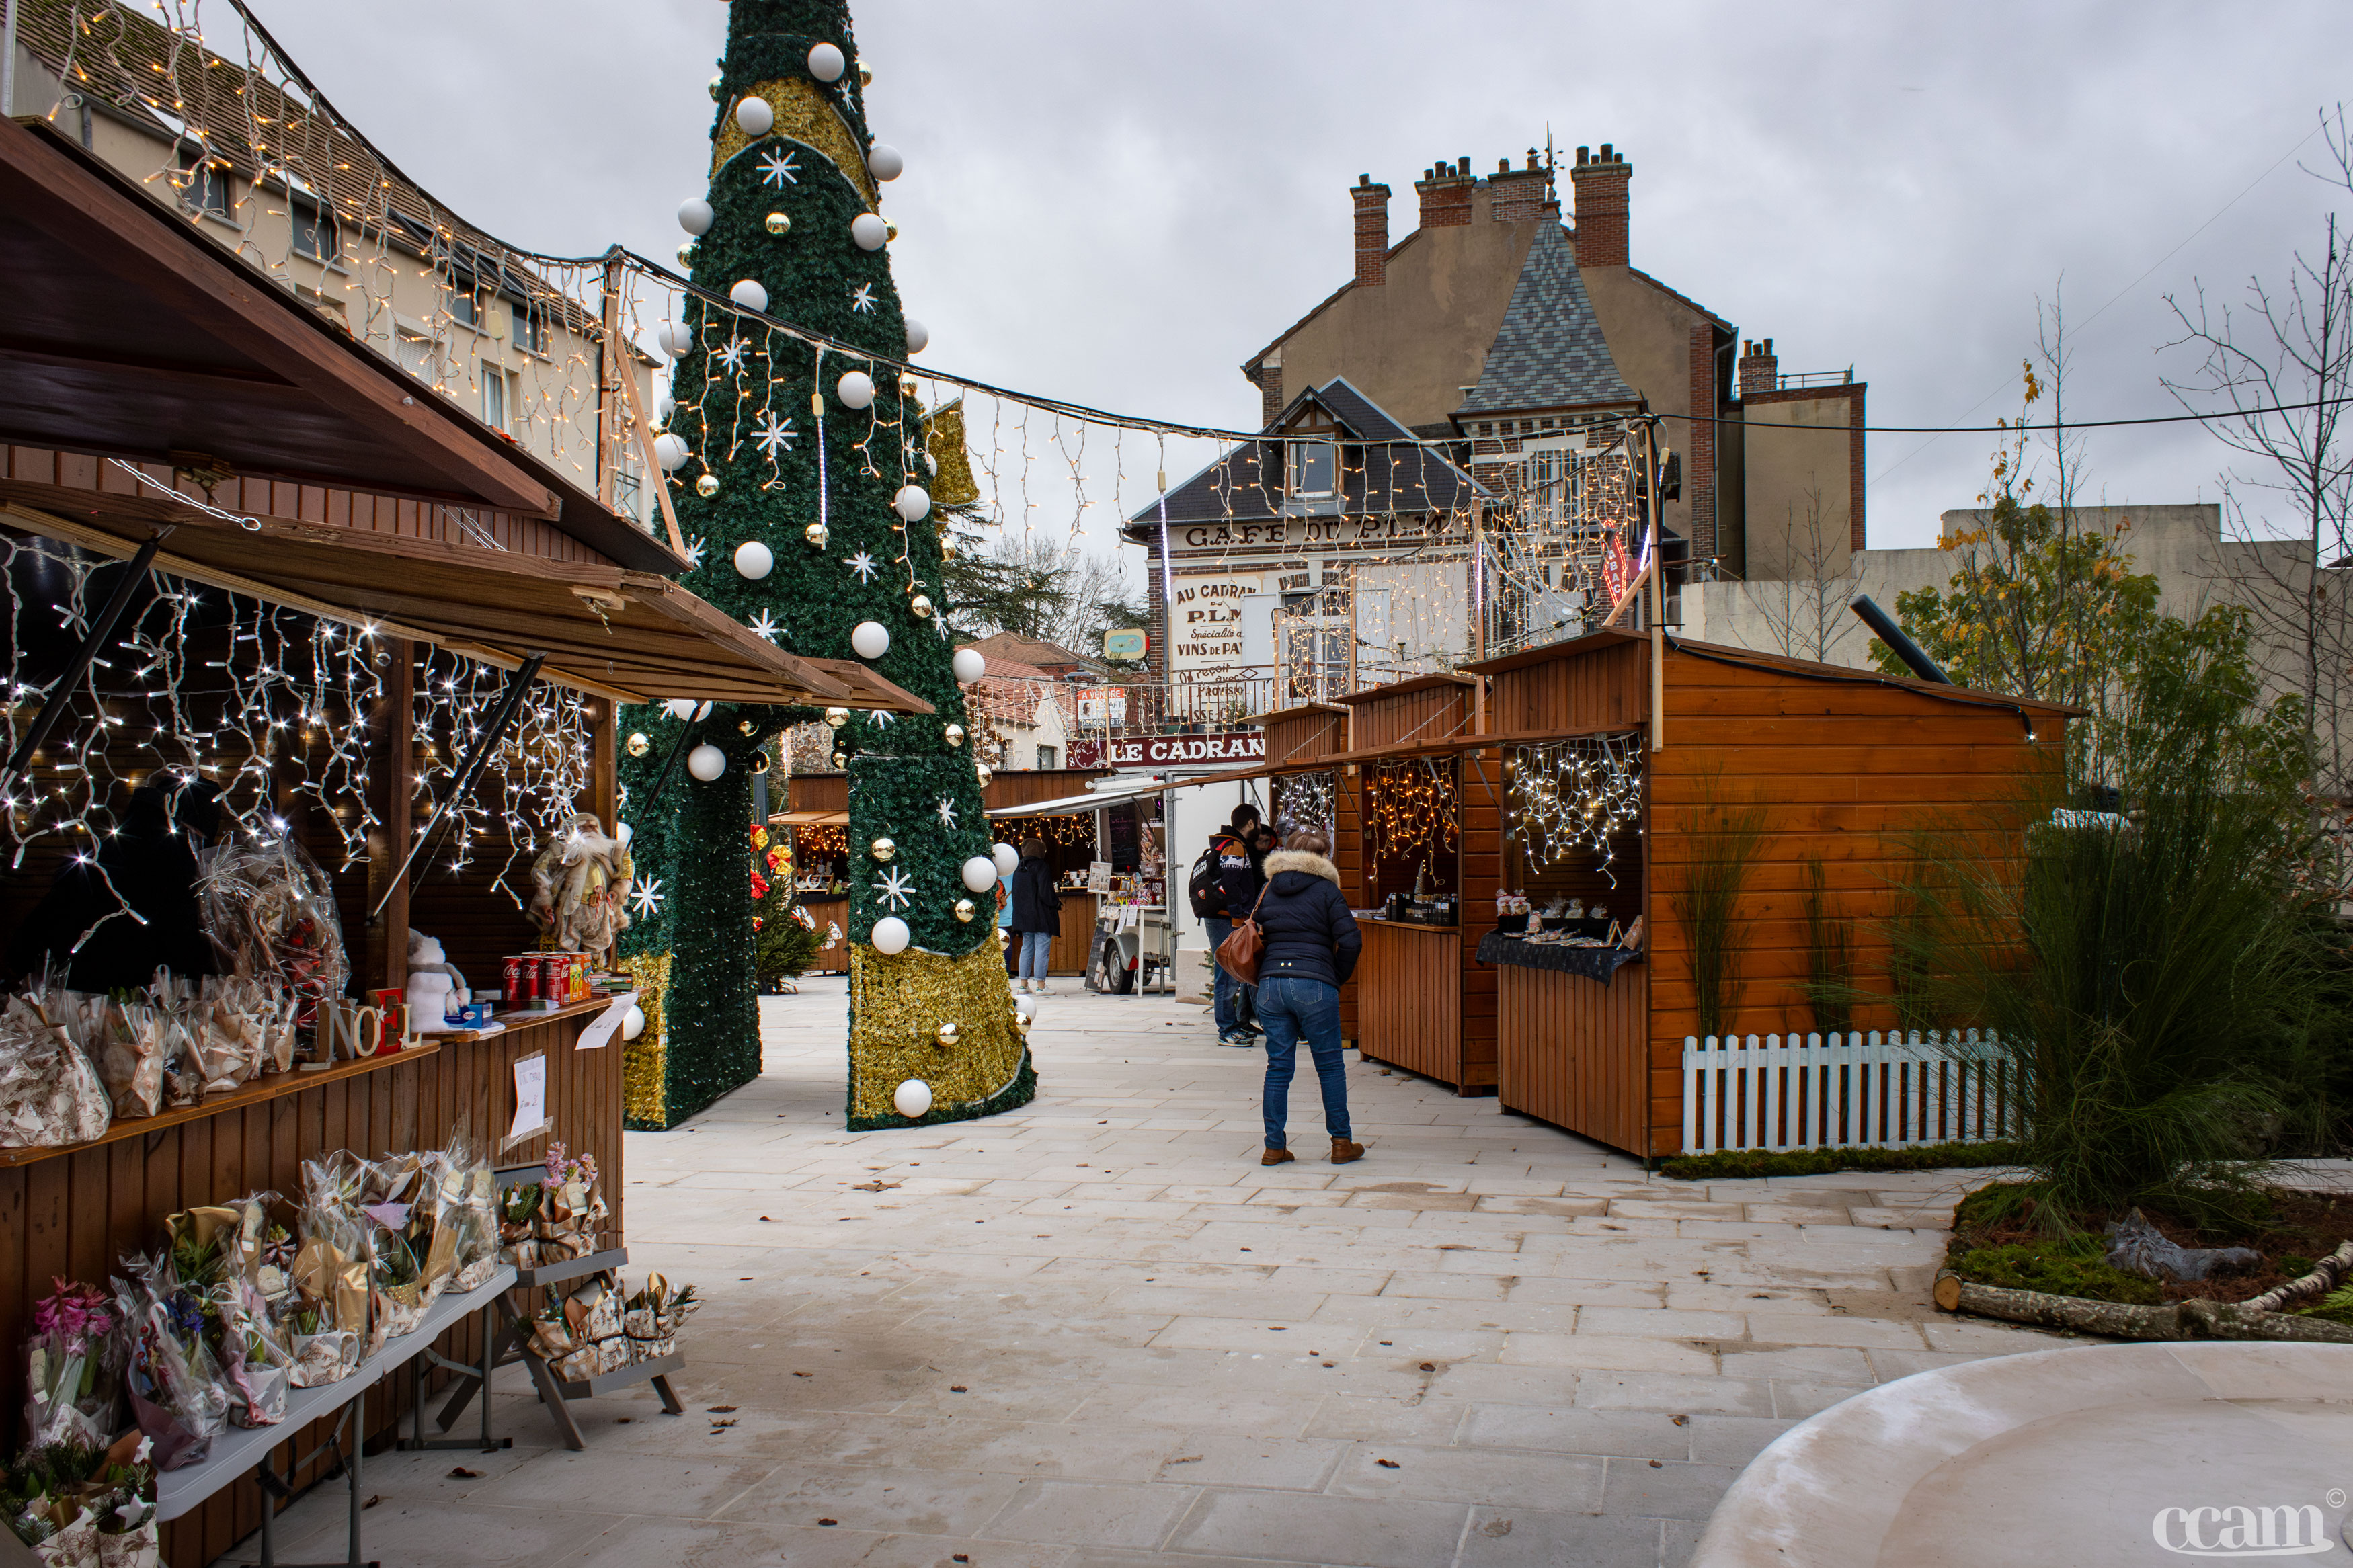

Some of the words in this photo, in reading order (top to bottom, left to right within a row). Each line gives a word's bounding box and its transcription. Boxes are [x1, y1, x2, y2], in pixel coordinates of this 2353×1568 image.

[1304, 522, 1341, 542] DU
[1609, 546, 1621, 593] ABAC
[1177, 588, 1195, 604] AU
[1177, 643, 1207, 656] VINS
[1210, 647, 1220, 655] DE
[1111, 743, 1142, 762] LE
[1150, 739, 1265, 761] CADRAN
[323, 988, 422, 1062] NOEL
